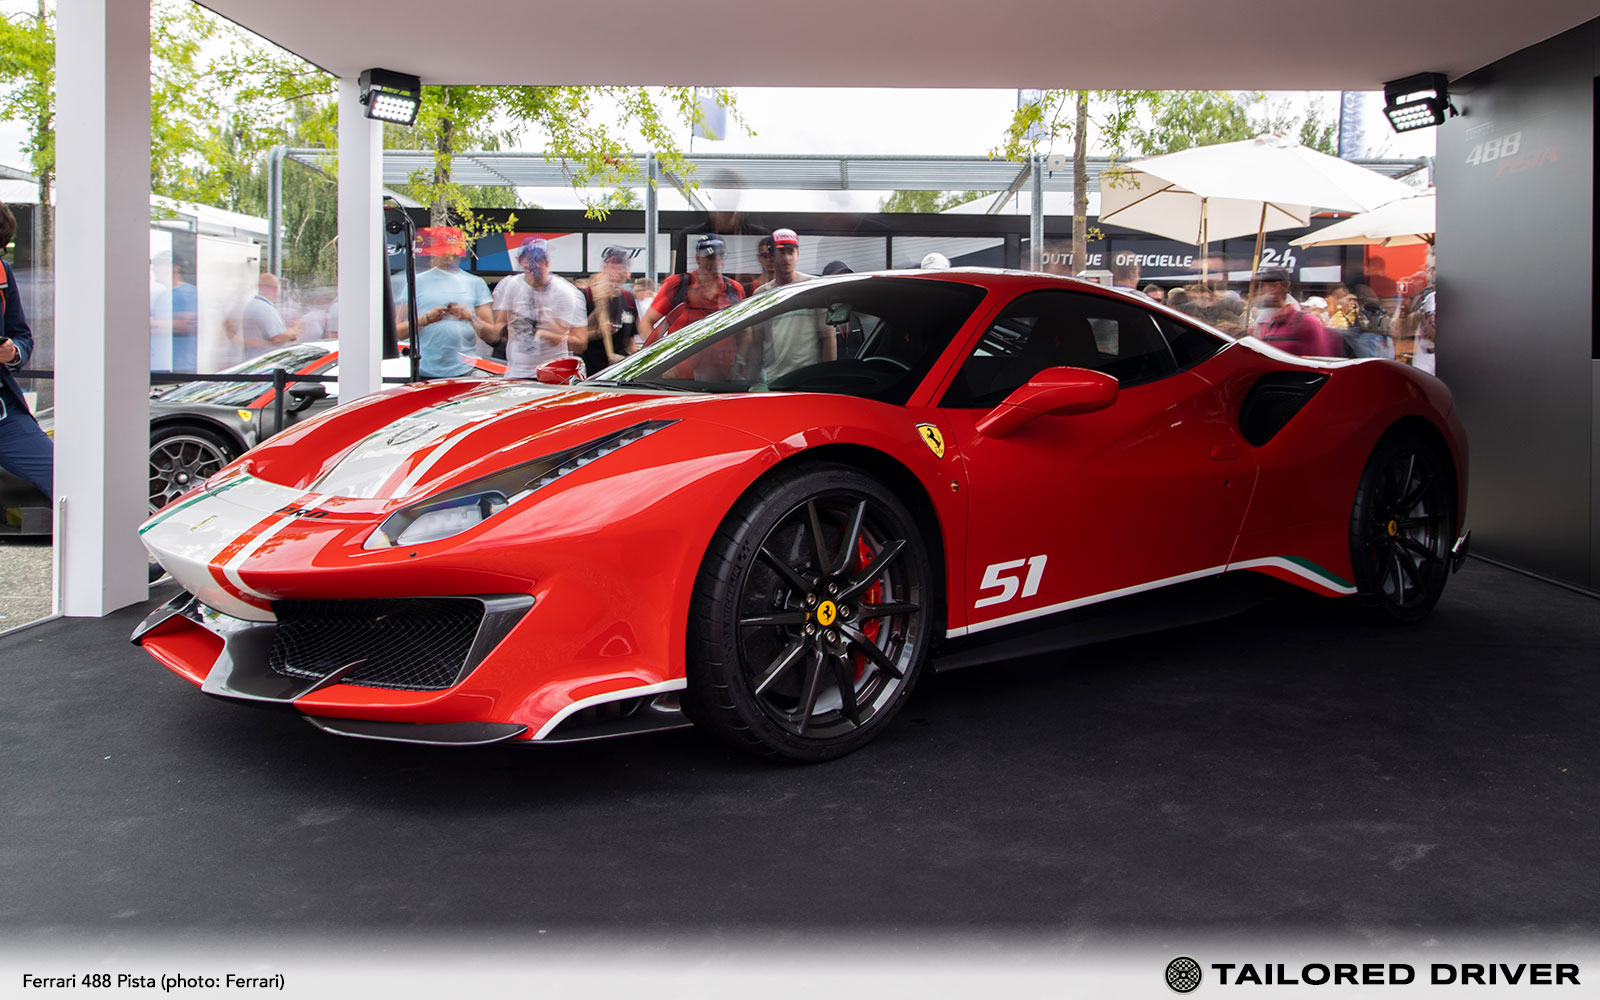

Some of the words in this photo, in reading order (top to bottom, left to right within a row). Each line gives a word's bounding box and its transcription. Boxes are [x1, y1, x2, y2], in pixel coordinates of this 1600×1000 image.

[1465, 131, 1522, 166] 488
[1116, 253, 1193, 268] OFFICIELLE
[974, 554, 1048, 609] 51
